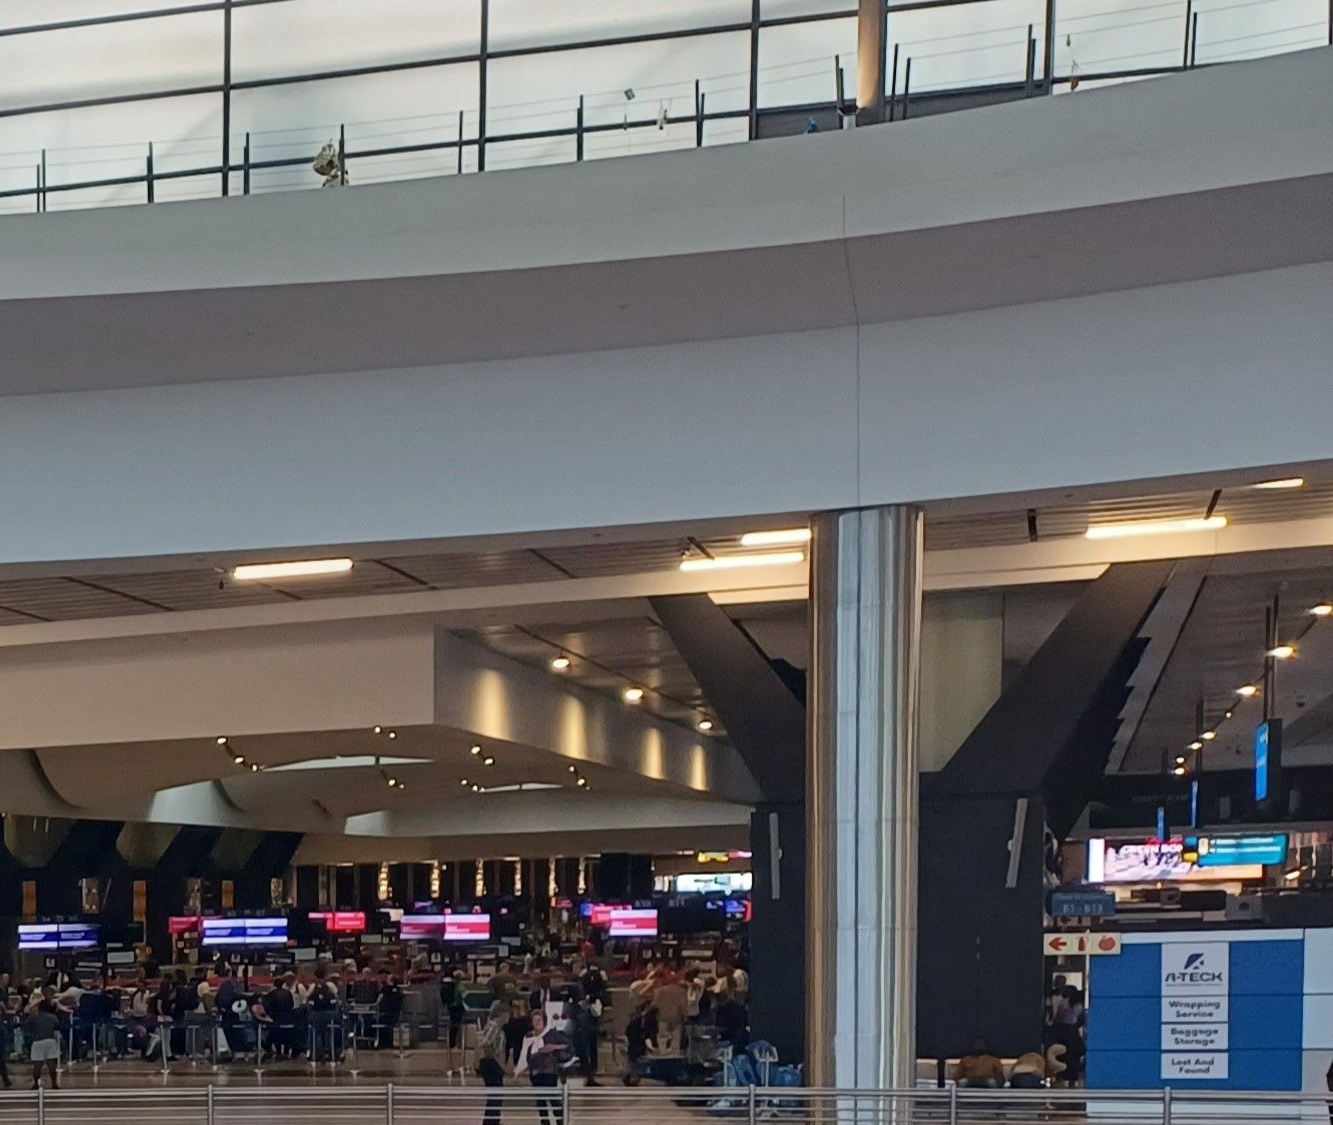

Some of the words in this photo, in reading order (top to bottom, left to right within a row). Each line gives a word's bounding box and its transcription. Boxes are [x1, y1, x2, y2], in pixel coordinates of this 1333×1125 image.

[1168, 1000, 1220, 1010] Wrapping
[1175, 1010, 1214, 1018] Service
[1171, 1027, 1218, 1037] Baggage
[1174, 1037, 1215, 1046] Storage
[1171, 1058, 1191, 1066] Lost
[1194, 1058, 1214, 1066] And
[1179, 1066, 1210, 1074] Found
